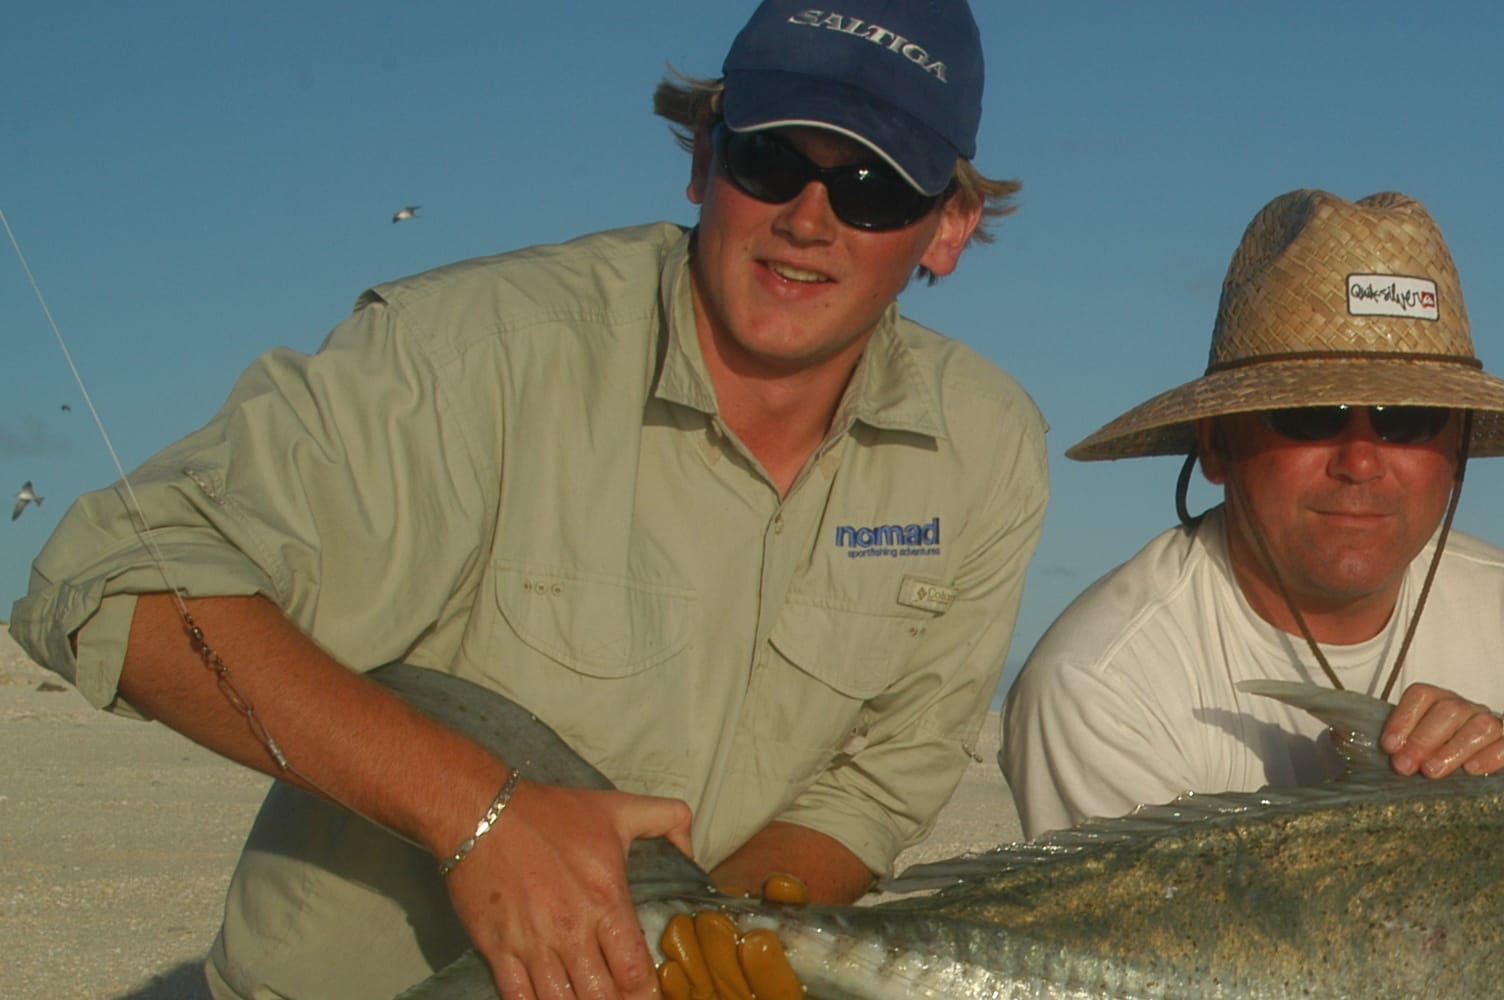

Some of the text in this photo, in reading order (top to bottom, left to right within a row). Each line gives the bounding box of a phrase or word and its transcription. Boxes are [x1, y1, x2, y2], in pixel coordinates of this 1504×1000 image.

[788, 10, 947, 83] SALTIGA
[836, 517, 940, 547] nomad
[848, 547, 941, 558] sportfishing adventures
